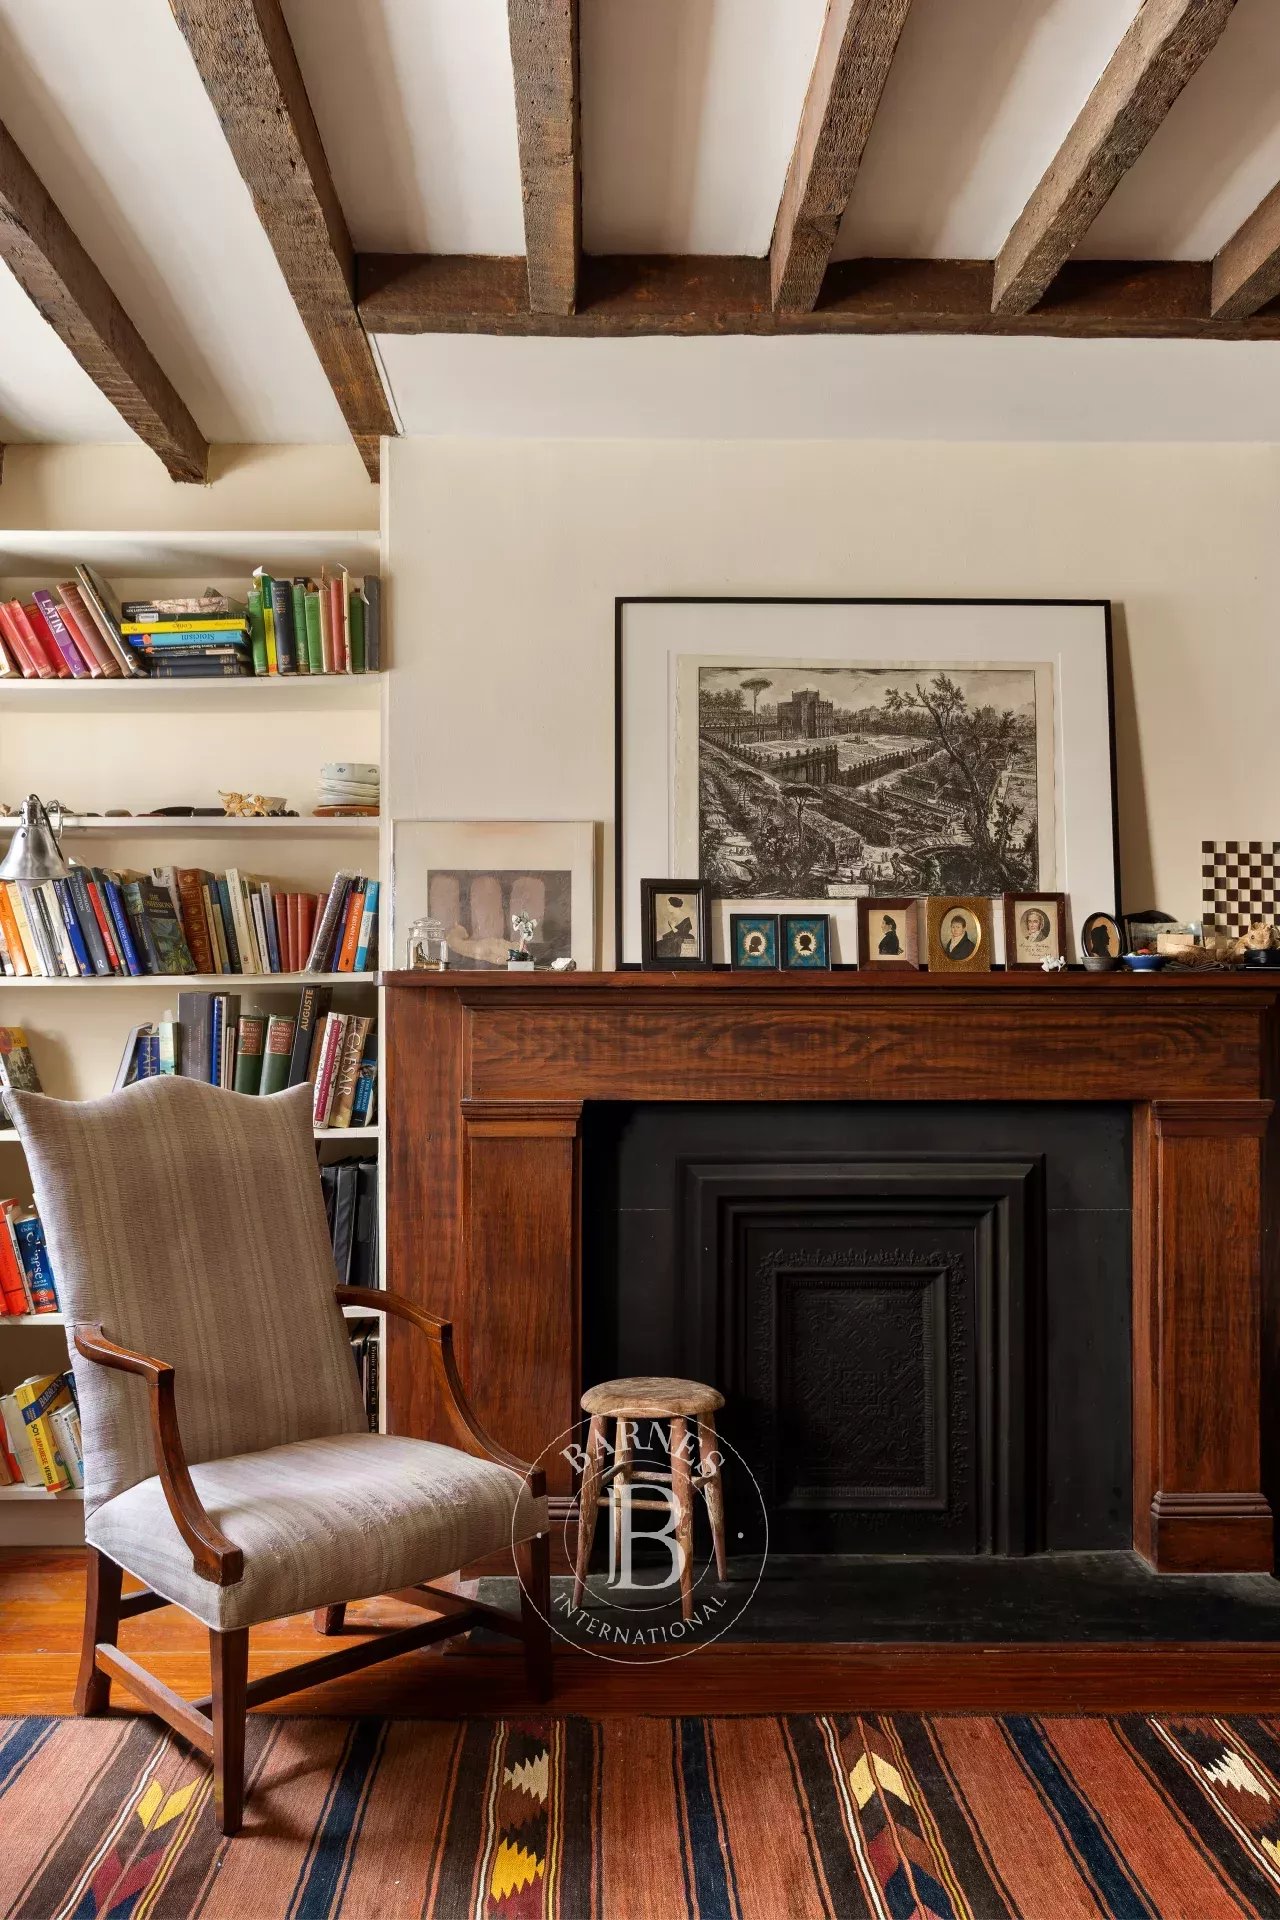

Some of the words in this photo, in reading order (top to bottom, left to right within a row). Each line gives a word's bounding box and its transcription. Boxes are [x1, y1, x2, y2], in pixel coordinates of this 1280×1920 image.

[42, 600, 64, 633] LATIN
[182, 633, 214, 642] Stoicism
[301, 988, 314, 1031] AUGUSTE
[338, 1032, 360, 1096] CAESAR
[30, 1423, 38, 1436] 501
[36, 1436, 48, 1465] JAPANESE
[44, 1464, 54, 1484] VERBS
